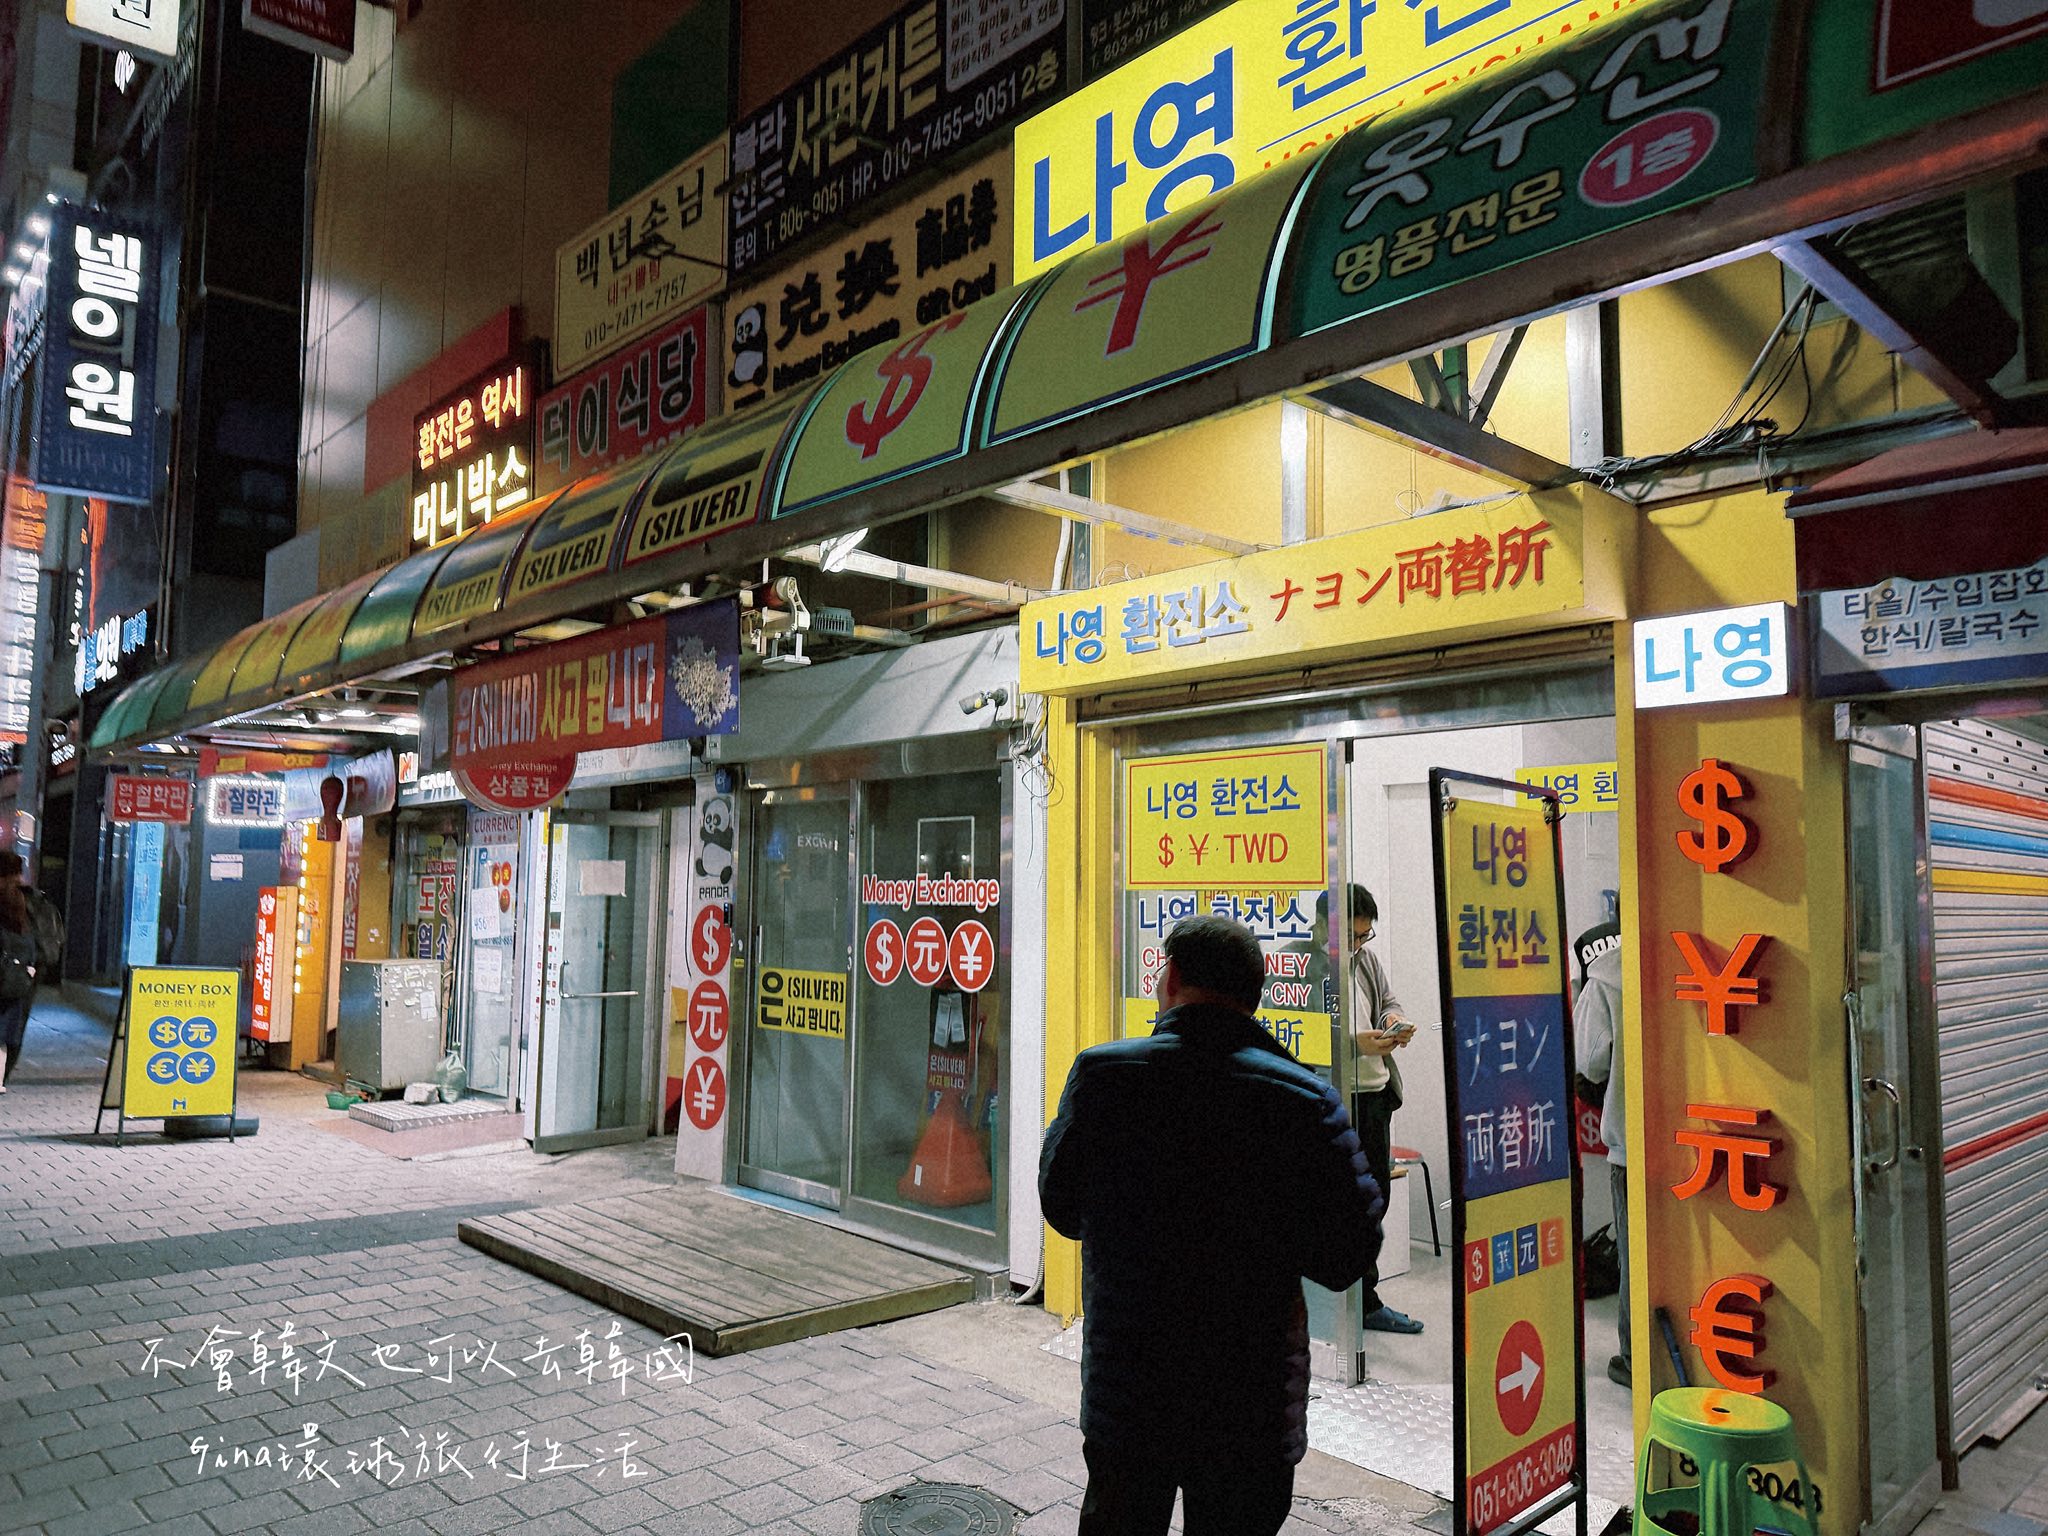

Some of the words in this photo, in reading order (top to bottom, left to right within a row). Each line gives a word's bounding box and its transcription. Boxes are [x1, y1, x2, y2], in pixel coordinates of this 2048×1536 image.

[852, 172, 877, 201] HP.
[882, 72, 1016, 182] 010-7455-9051
[1022, 47, 1057, 99] 2층
[1344, 0, 1732, 229] 옷수선
[1034, 46, 1234, 262] 나영
[1599, 126, 1696, 189] 1층
[1334, 170, 1565, 295] 명품전문
[585, 272, 687, 350] 010-7471-7757
[418, 399, 474, 469] 환전은
[482, 366, 521, 428] 역시
[413, 446, 527, 547] 머니박스
[640, 480, 752, 550] (SILVER)
[519, 534, 606, 591] (SILVER)
[1035, 606, 1107, 666] 나영
[1120, 580, 1254, 655] 환전소
[1862, 609, 2040, 657] 한식/칼국수
[1645, 618, 1772, 692] 나영
[136, 782, 186, 808] 철학관
[229, 787, 278, 816] 철학관
[488, 775, 550, 798] 상품권
[1147, 780, 1197, 819] 나영
[1210, 775, 1301, 816] 환전소
[1676, 758, 1747, 873] $
[1472, 822, 1528, 887] 나영
[419, 875, 456, 917] 도장
[698, 886, 730, 899] PANDA
[863, 874, 915, 911] Money
[917, 872, 999, 913] Exchange
[702, 910, 720, 970] $
[875, 926, 893, 978] $
[913, 930, 940, 973] 元
[959, 932, 982, 981] ¥
[1457, 903, 1550, 969] 환전소
[139, 983, 197, 995] MONEY
[201, 984, 232, 996] BOX
[761, 972, 784, 1027] 은
[787, 976, 844, 1003] (SILVER)
[1671, 932, 1761, 1035] ¥
[155, 1021, 177, 1044] $
[188, 1023, 211, 1042] 元
[695, 991, 722, 1040] 元
[151, 1058, 174, 1079] €
[186, 1057, 209, 1078] ¥
[1464, 1014, 1549, 1086] ナヨン
[693, 1065, 718, 1121] ¥
[1671, 1104, 1775, 1211] 元
[1520, 1232, 1535, 1266] 元
[1689, 1273, 1770, 1393] €
[1473, 1434, 1573, 1528] 051-806-3048
